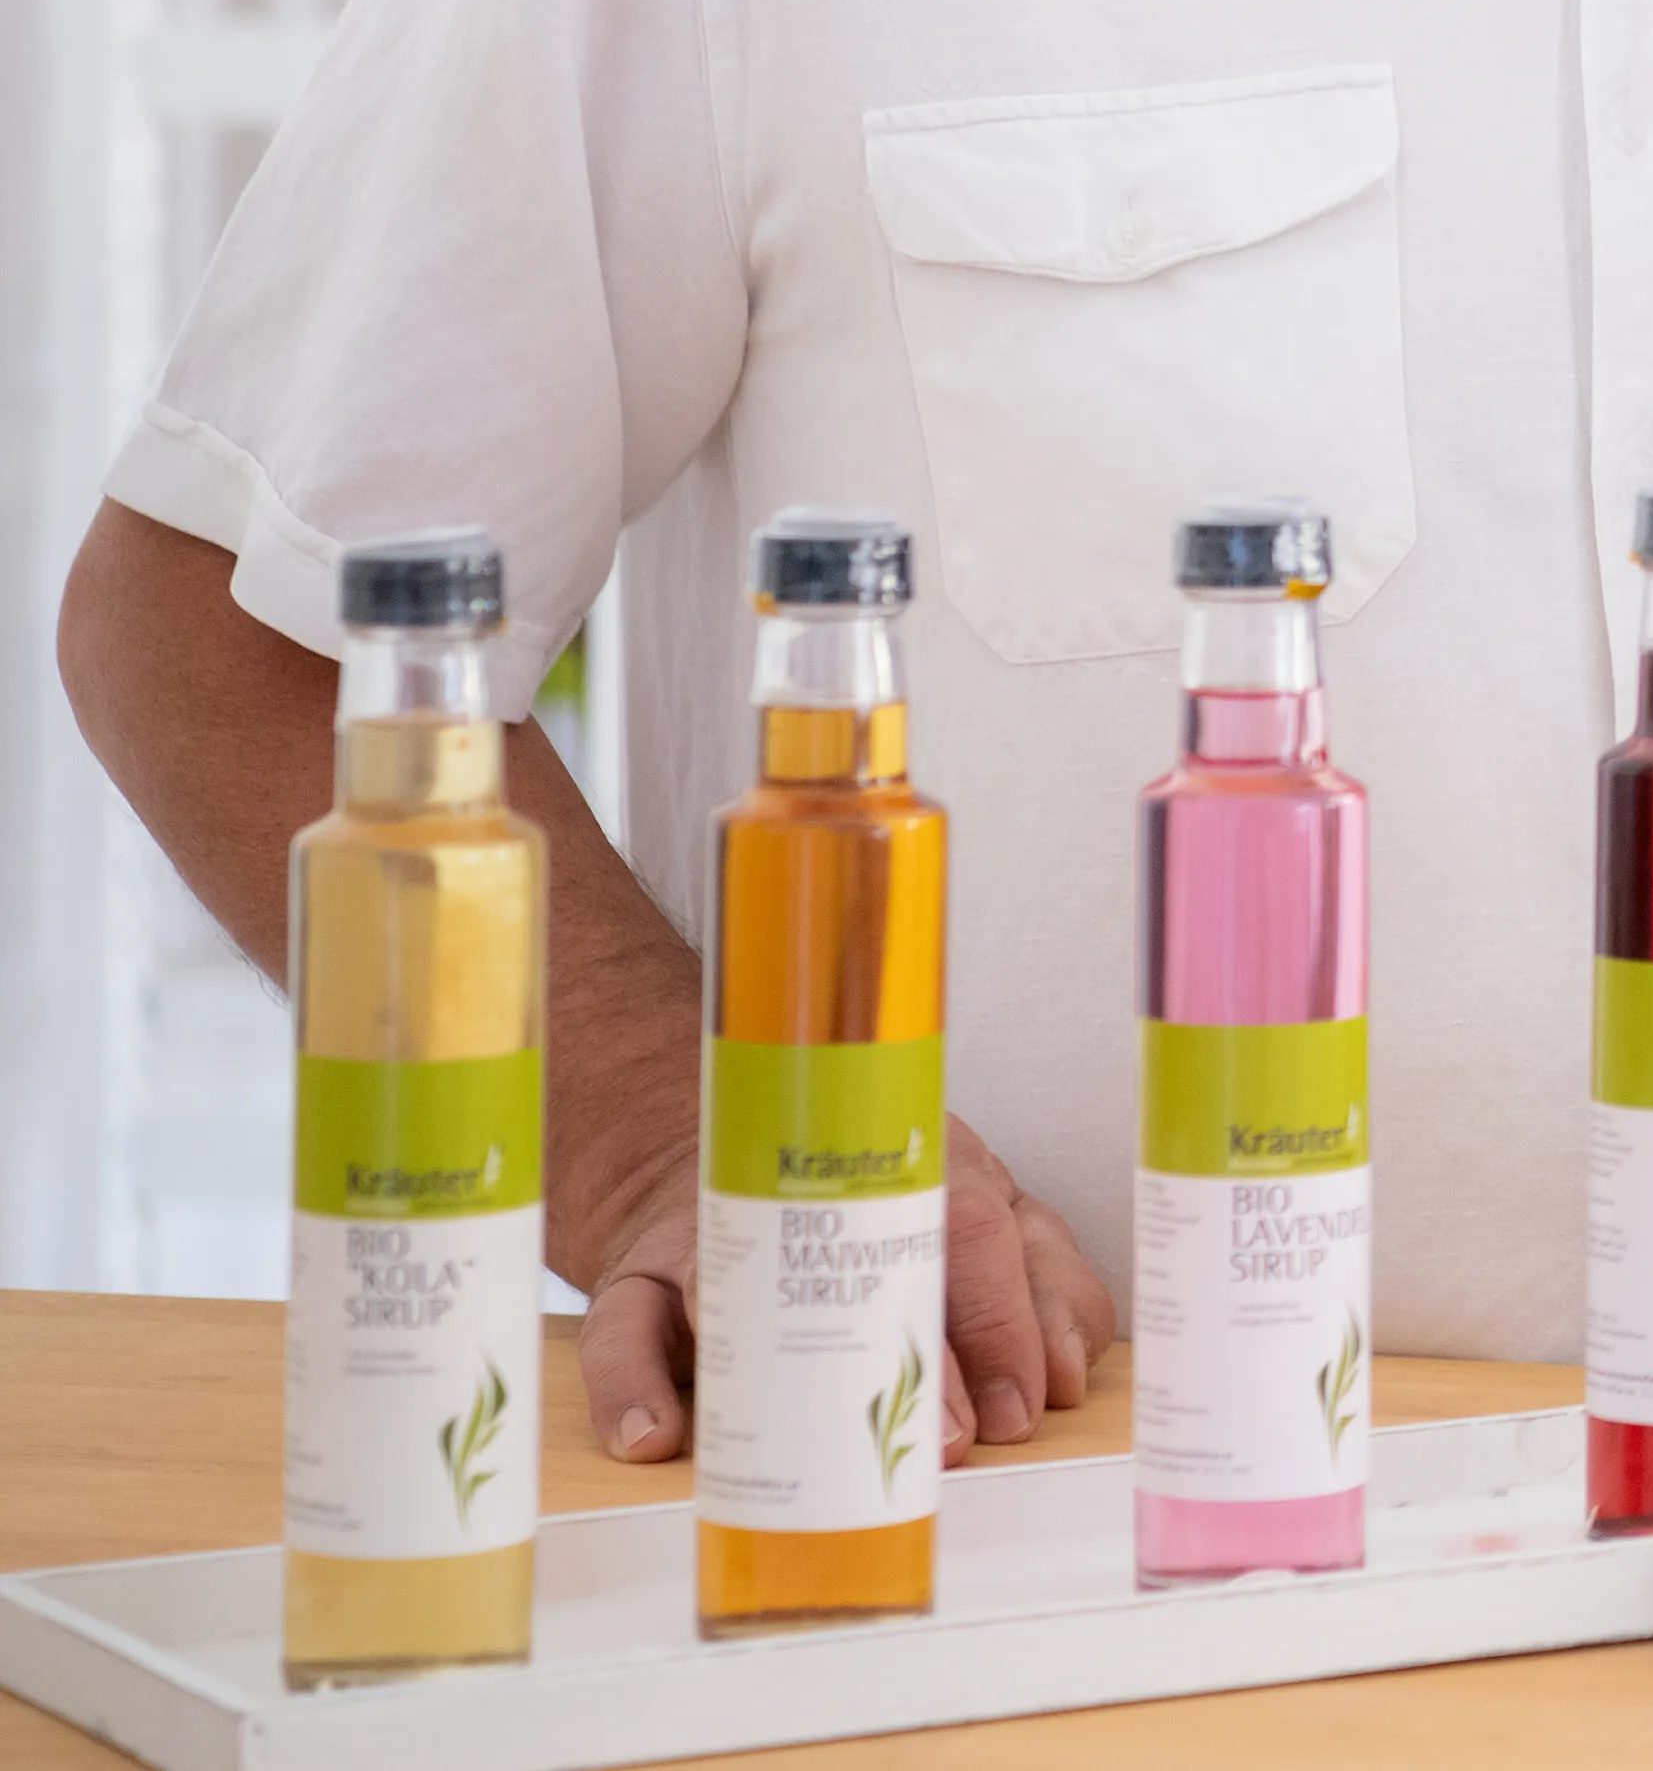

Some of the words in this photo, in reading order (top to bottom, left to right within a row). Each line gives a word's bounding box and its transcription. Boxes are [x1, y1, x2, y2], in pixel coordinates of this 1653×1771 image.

[1228, 1124, 1345, 1156] Kräuter
[777, 1145, 906, 1179] Kräuter
[1231, 1184, 1293, 1216] BIO
[779, 1207, 844, 1240] BIO
[346, 1227, 411, 1259] BIO
[1229, 1247, 1329, 1282] SIRUP
[776, 1273, 884, 1308] SIRUP
[343, 1295, 454, 1329] SIRUP
